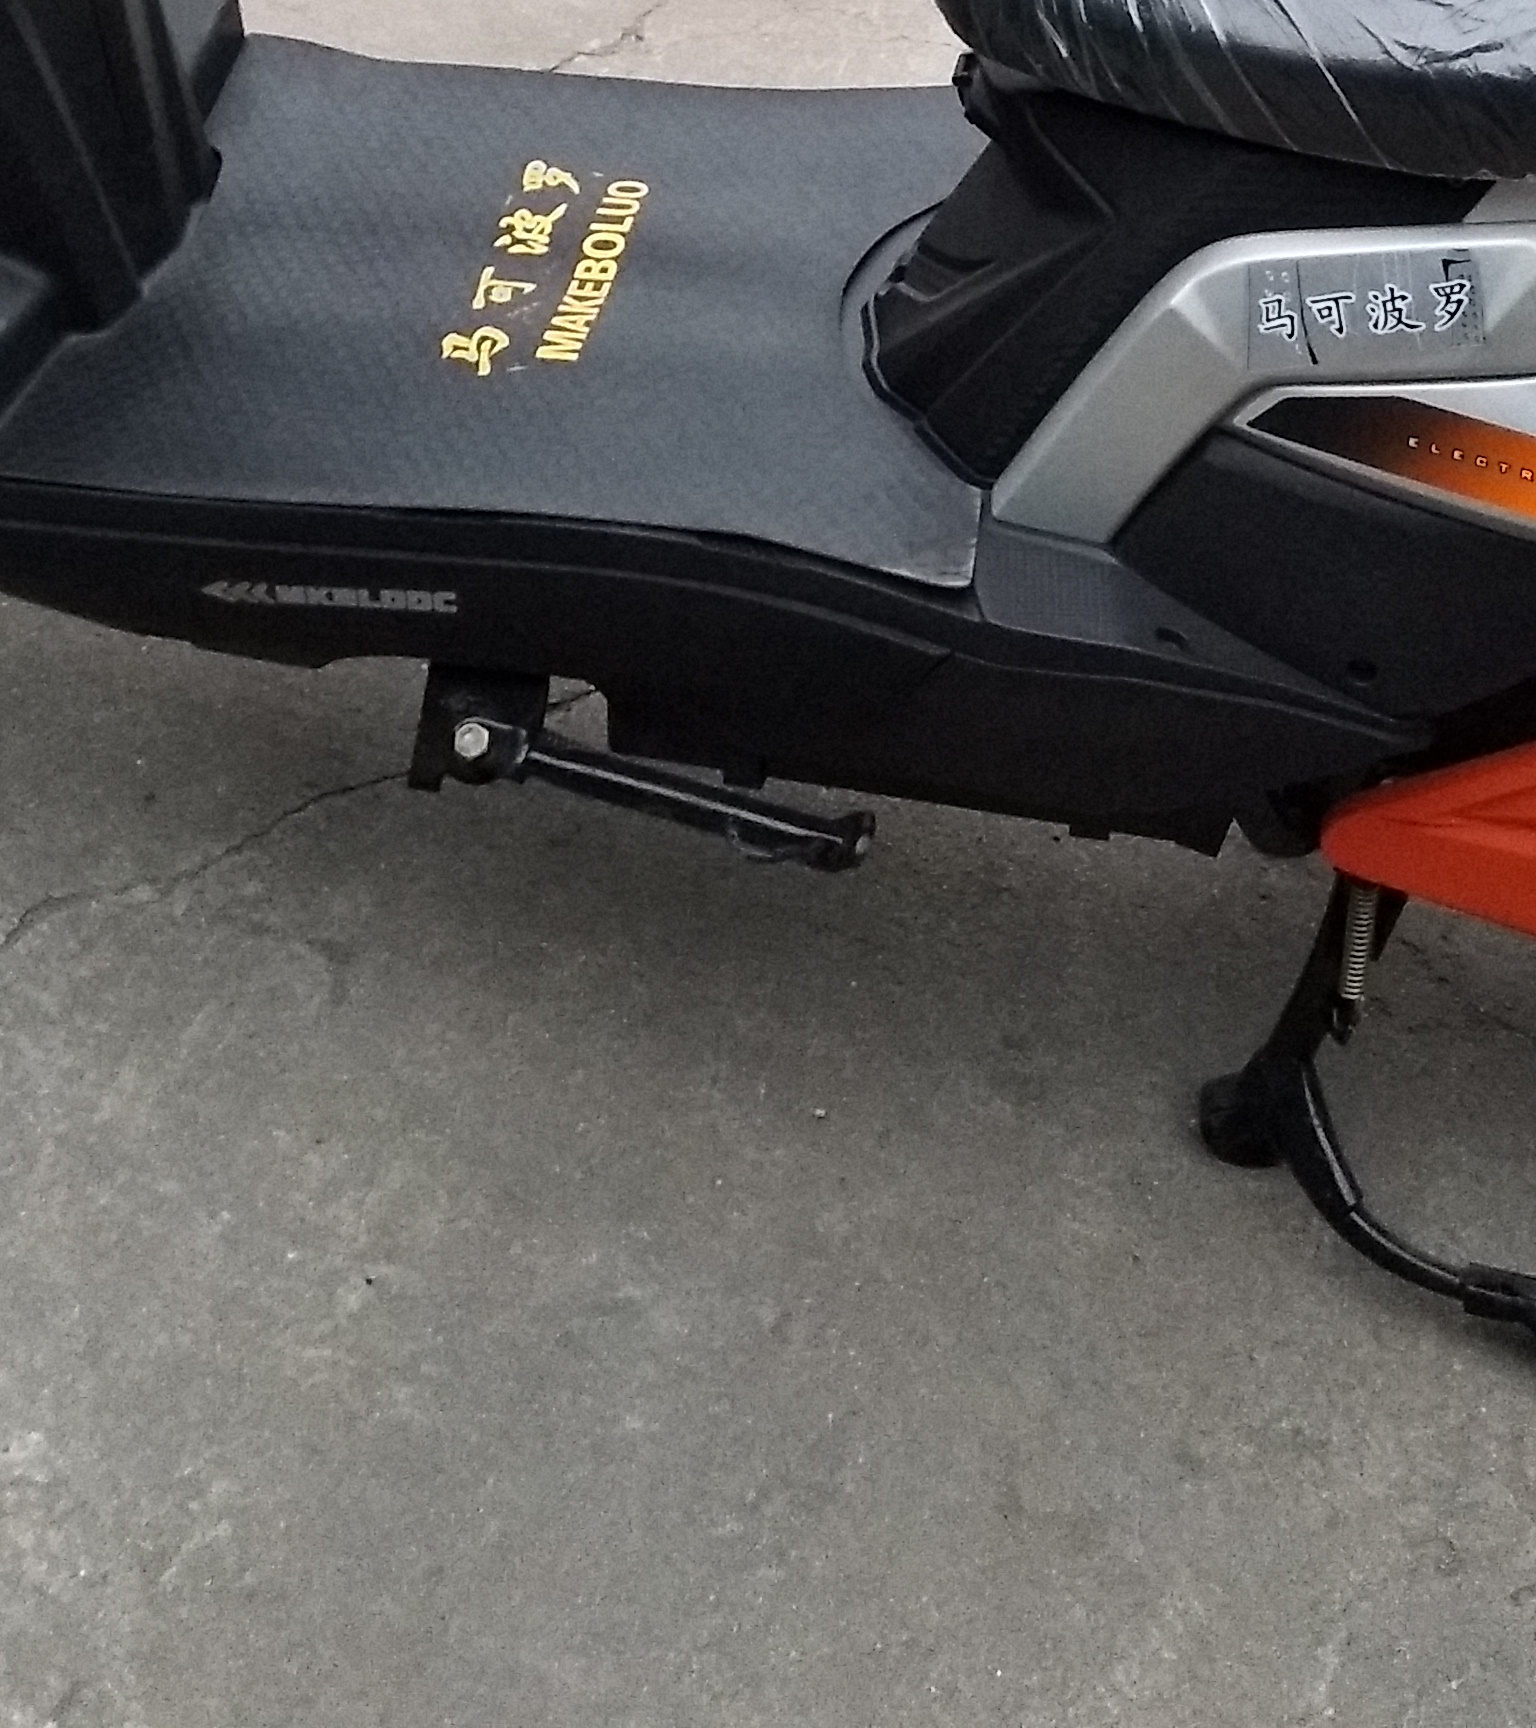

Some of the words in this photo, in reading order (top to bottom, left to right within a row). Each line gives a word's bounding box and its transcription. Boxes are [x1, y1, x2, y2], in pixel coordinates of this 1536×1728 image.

[441, 159, 580, 376] 马可波罗
[535, 180, 650, 361] MAKEBOLUO
[1258, 279, 1470, 340] 马可波罗
